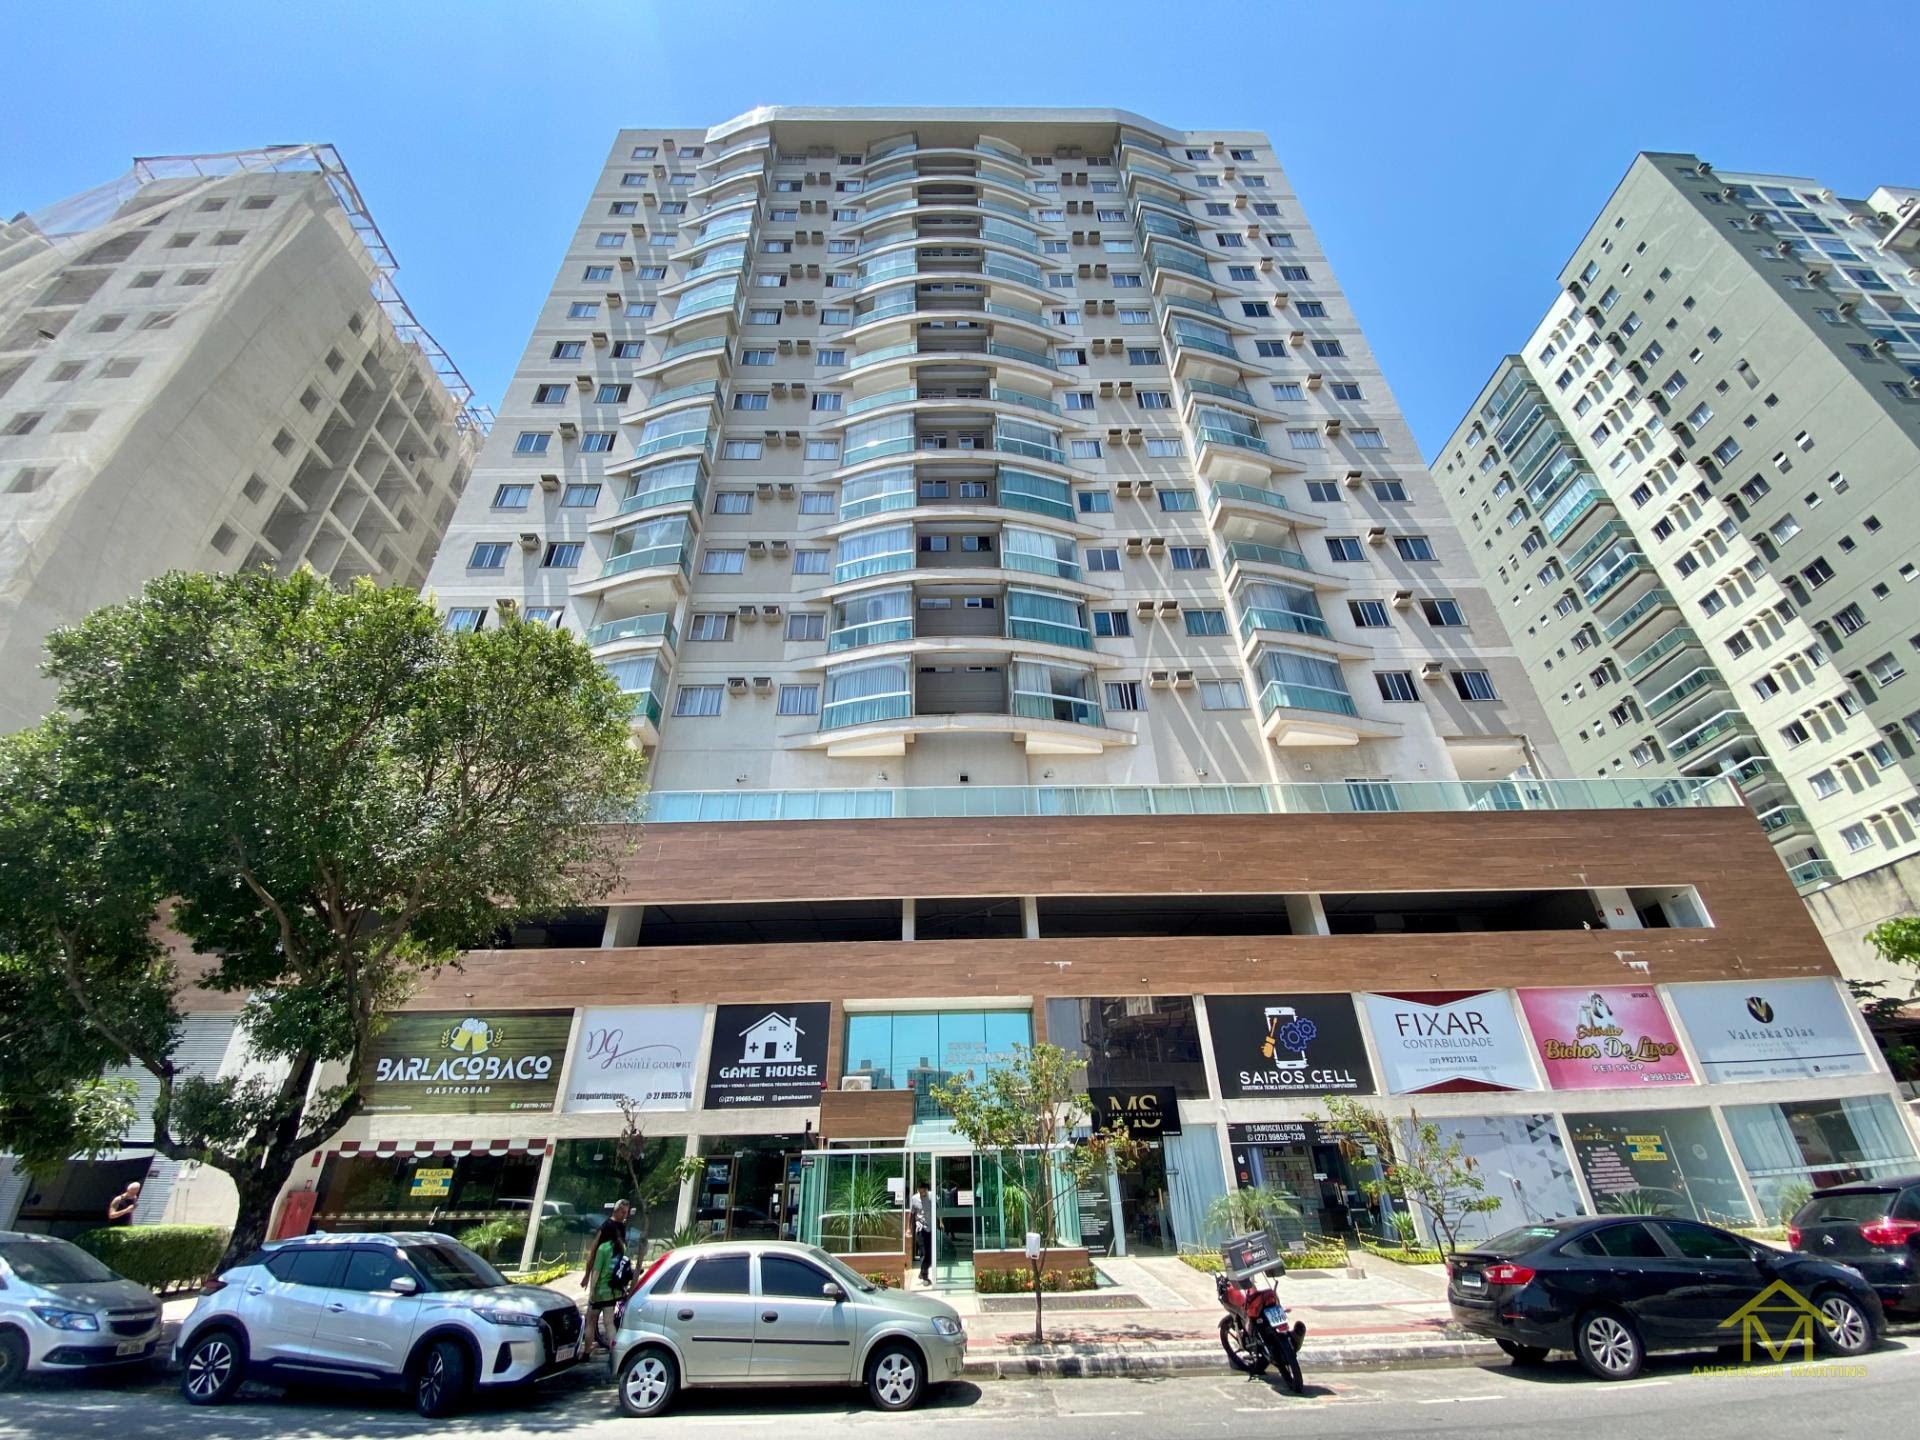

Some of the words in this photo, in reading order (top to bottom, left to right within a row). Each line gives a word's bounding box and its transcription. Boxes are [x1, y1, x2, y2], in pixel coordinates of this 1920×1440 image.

[1395, 1012, 1490, 1036] FIXAR
[1727, 1028, 1782, 1040] Valeska
[1784, 1027, 1815, 1038] Dias
[1403, 1038, 1494, 1048] CONTABILIDADE
[1544, 1038, 1601, 1059] Bichos
[1604, 1036, 1632, 1058] De
[1628, 1036, 1678, 1062] Luxo
[720, 1066, 761, 1078] GAME
[766, 1065, 817, 1077] HOUSE
[1592, 1064, 1612, 1072] PET
[1615, 1063, 1644, 1072] SHOP
[1240, 1070, 1305, 1084] SAIROS
[1311, 1069, 1356, 1083] CELL
[426, 1086, 491, 1095] GASTROBAR
[1108, 1094, 1162, 1128] MS
